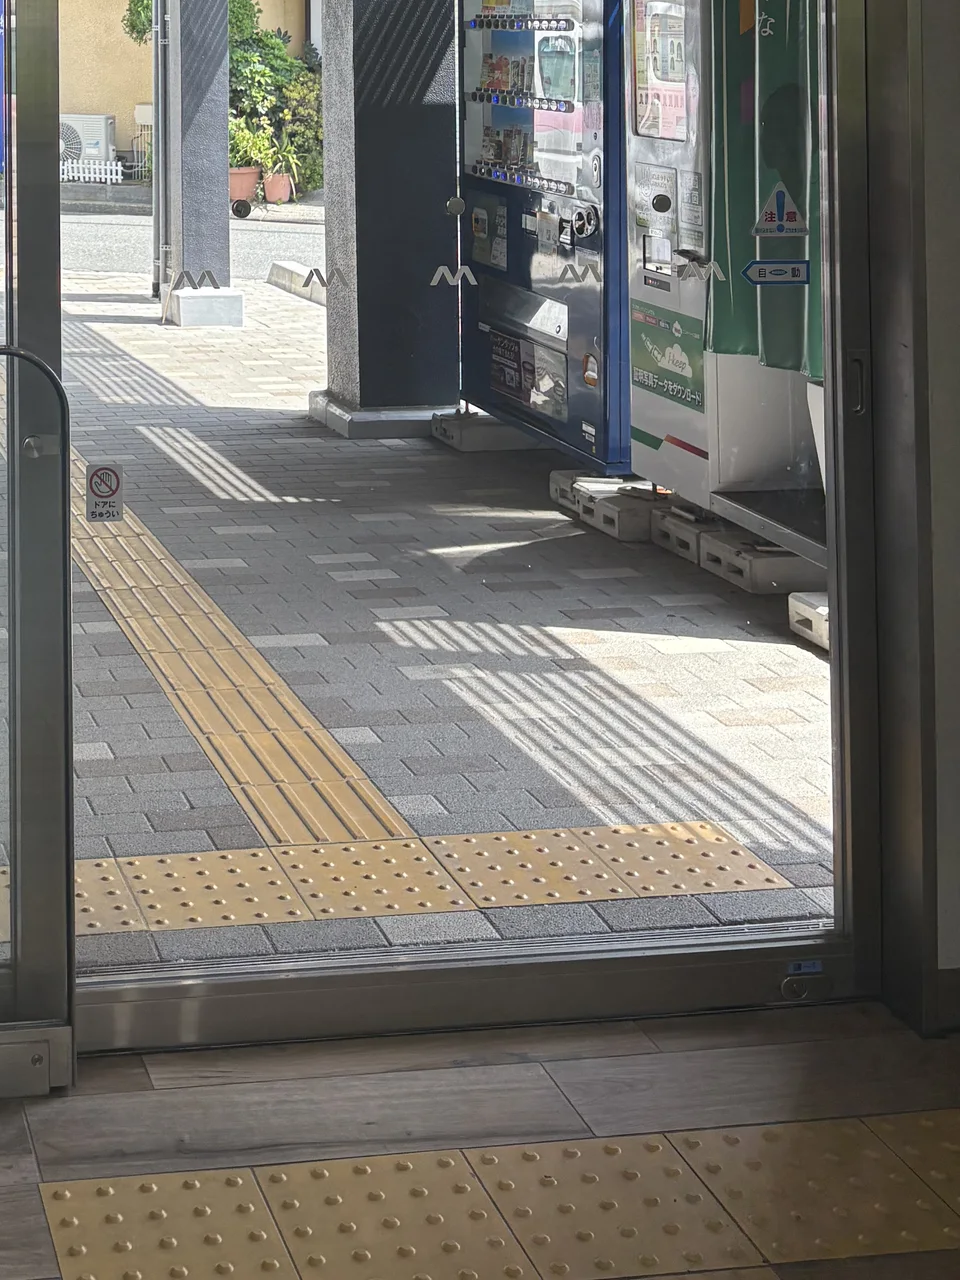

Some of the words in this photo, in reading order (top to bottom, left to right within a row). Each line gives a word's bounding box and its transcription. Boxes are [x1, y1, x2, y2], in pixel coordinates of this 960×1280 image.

[94, 501, 116, 509] ドアに
[90, 510, 120, 518] ちゅうい
